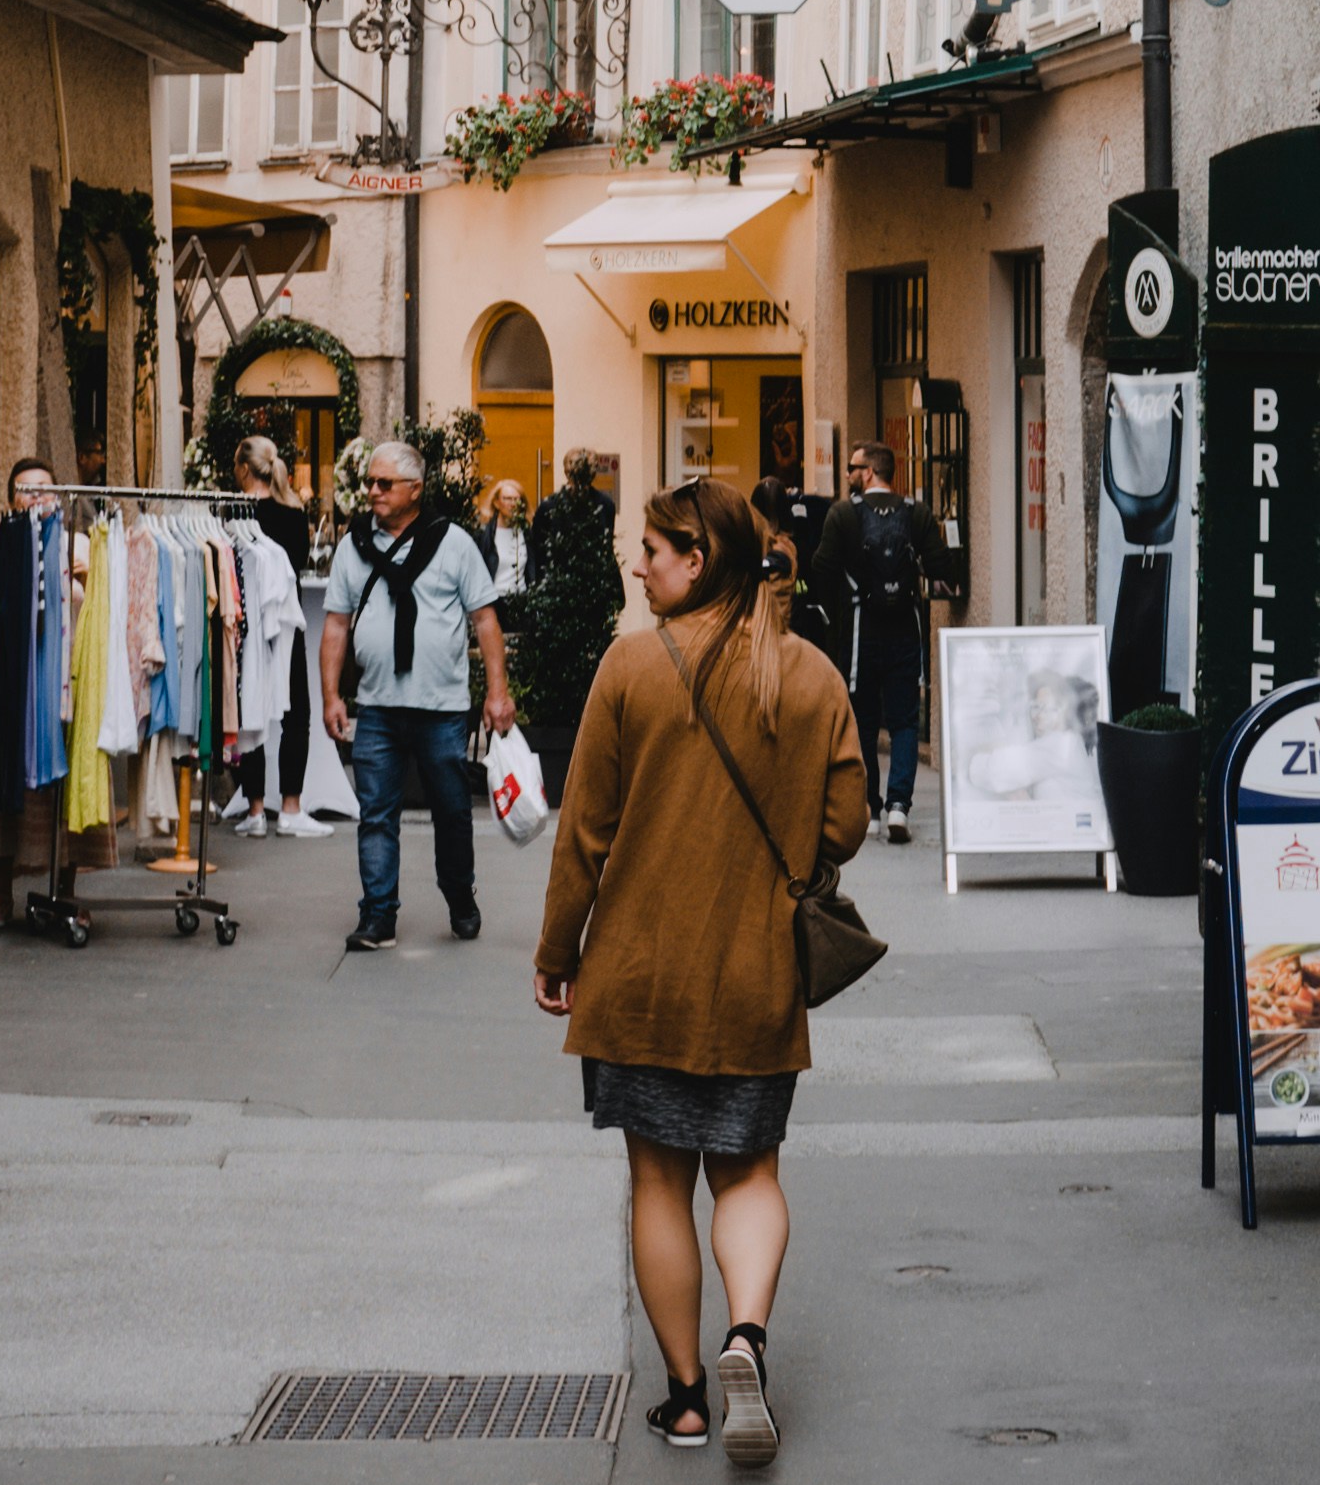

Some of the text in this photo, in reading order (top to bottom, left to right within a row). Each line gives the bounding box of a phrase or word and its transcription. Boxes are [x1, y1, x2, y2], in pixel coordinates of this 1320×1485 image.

[348, 173, 423, 191] AIGNER
[605, 249, 679, 269] HOLZKERN
[1216, 244, 1320, 269] brillenmacher
[674, 299, 790, 327] HOLZKERN
[1108, 391, 1183, 420] SARCK
